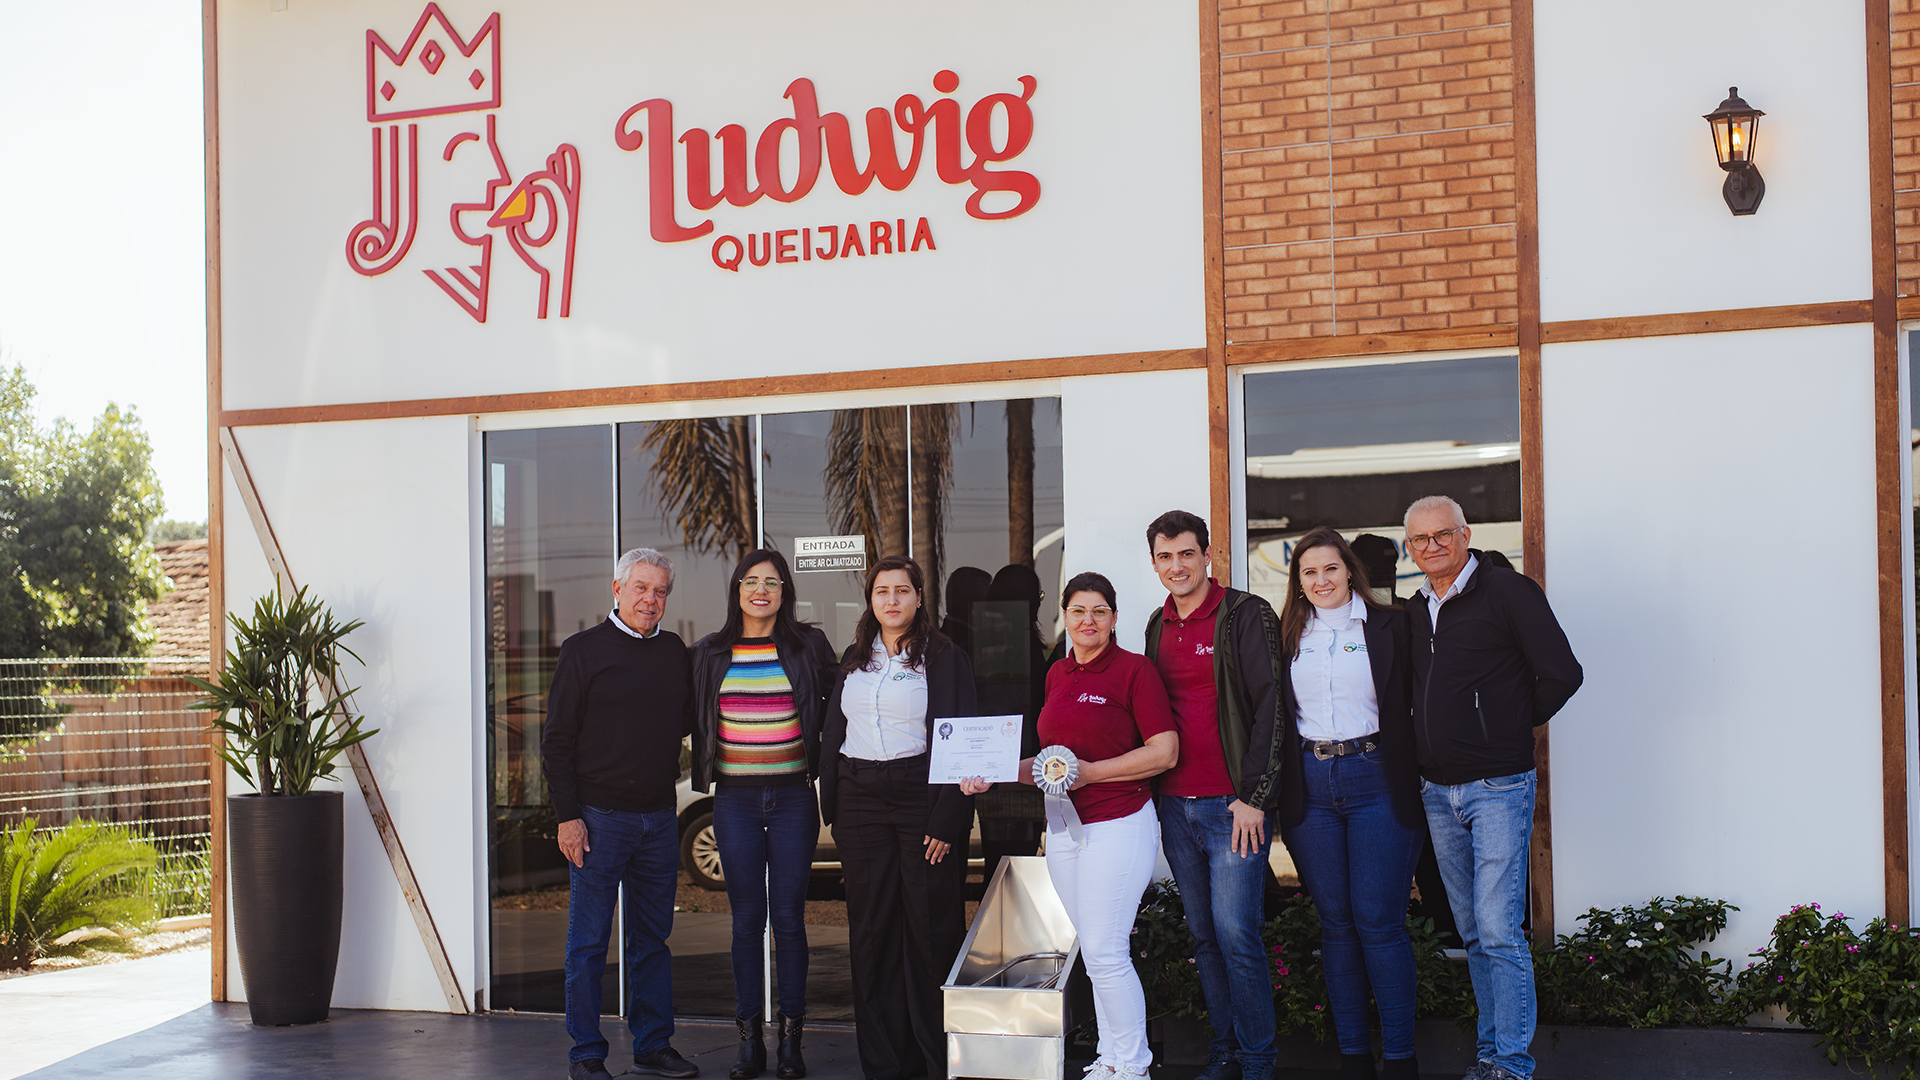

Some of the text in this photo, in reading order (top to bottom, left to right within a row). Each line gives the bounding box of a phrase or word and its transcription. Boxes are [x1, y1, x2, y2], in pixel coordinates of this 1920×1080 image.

[615, 70, 1041, 243] Ludwig
[711, 217, 936, 272] QUEIJARIA
[802, 540, 856, 550] ENTRADA
[798, 556, 862, 568] ENTRE AR CLIMATIZADO
